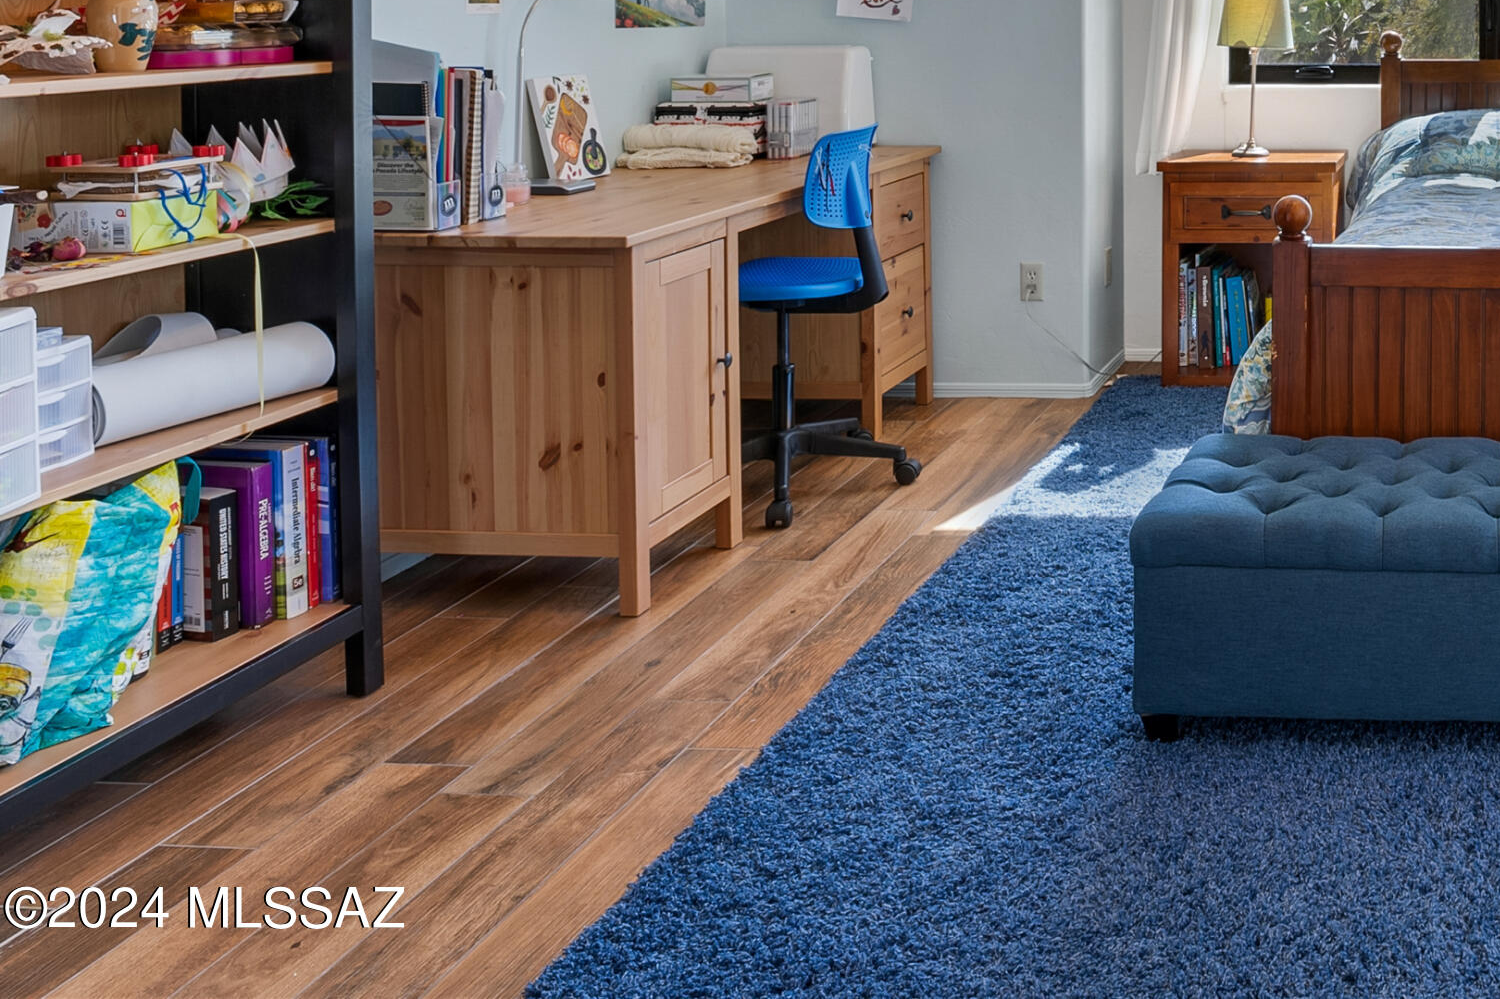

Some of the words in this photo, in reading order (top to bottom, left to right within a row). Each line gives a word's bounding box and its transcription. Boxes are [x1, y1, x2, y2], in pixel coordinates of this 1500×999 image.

[291, 477, 302, 532] Intermediate
[218, 508, 228, 532] UNITED
[258, 498, 269, 561] PRE-ALGEBRA
[220, 533, 228, 553] STATES
[290, 533, 302, 565] Algebra
[220, 553, 229, 579] HISTORY
